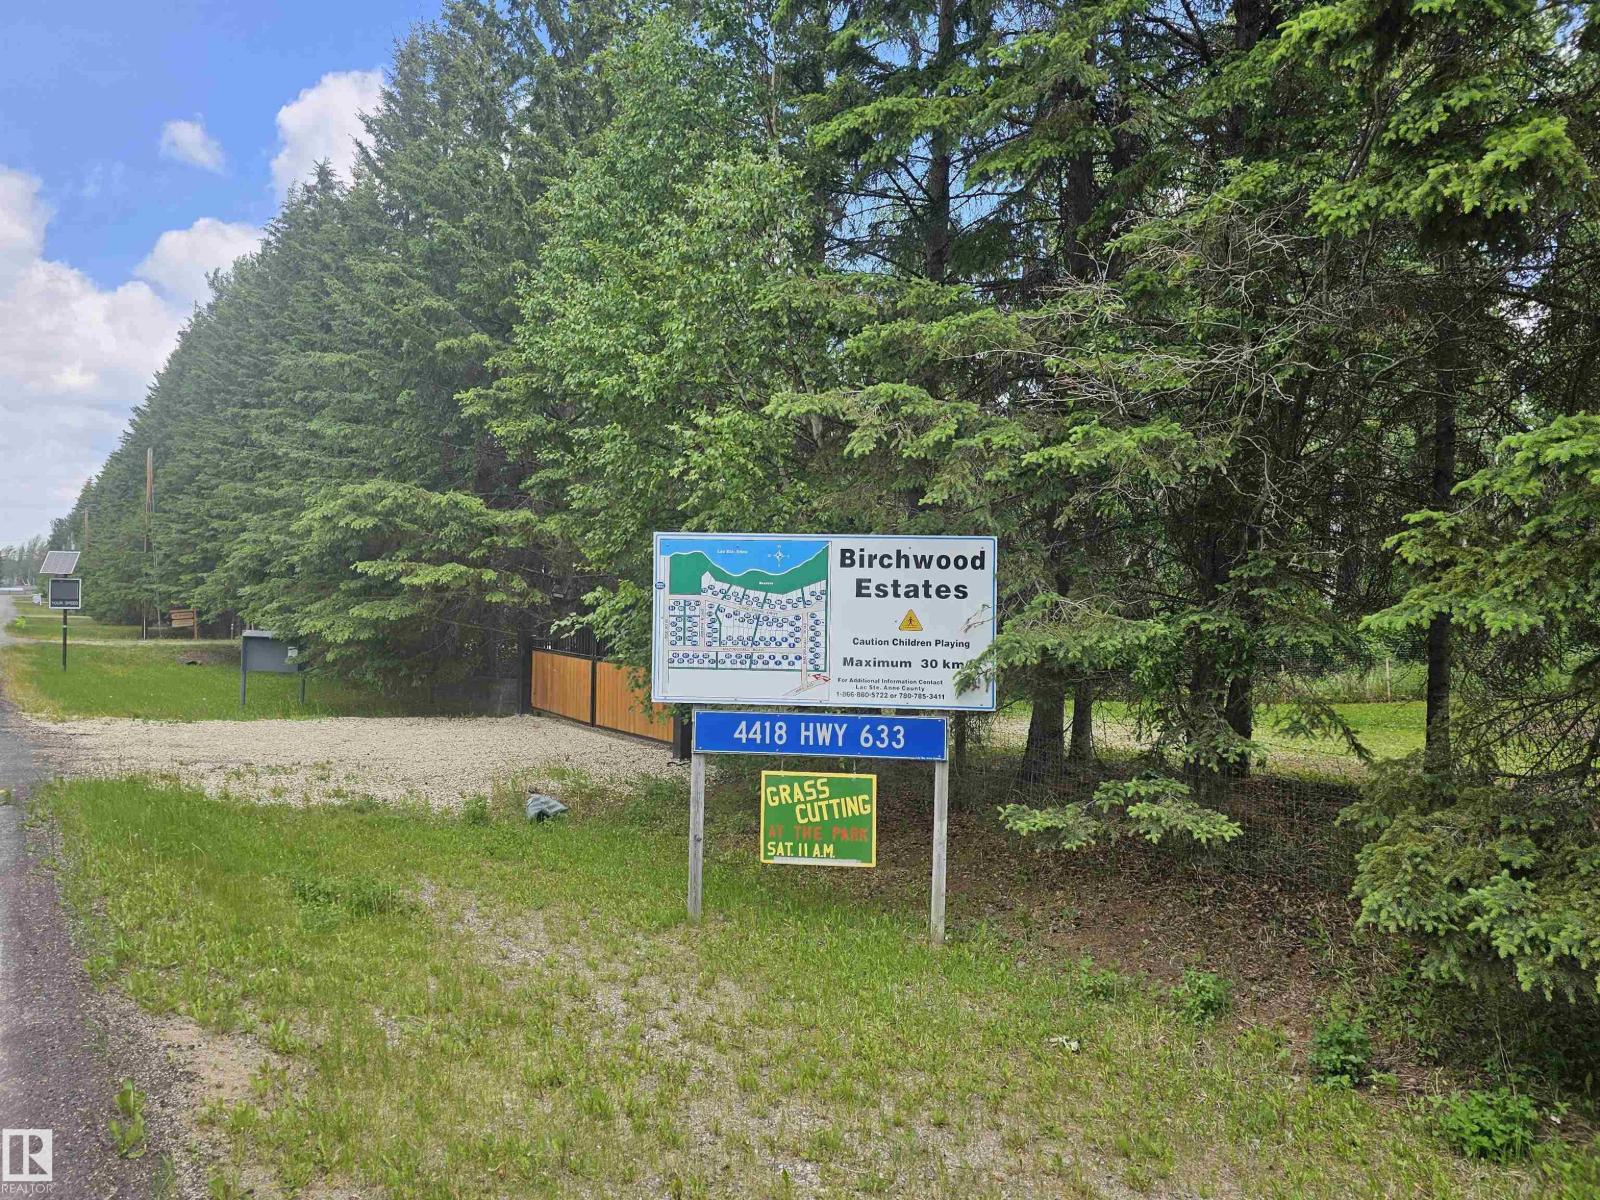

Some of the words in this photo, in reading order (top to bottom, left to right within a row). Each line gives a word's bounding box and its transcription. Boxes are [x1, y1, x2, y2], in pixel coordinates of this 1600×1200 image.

[839, 548, 986, 571] Birchwood
[855, 578, 969, 600] Estates
[852, 637, 889, 646] Caution
[892, 638, 932, 648] Children
[935, 639, 970, 649] Playing
[842, 657, 912, 669] Maximum
[921, 659, 938, 669] 30
[898, 692, 945, 700] 780-785-3411
[733, 720, 787, 745] 4418
[800, 722, 848, 747] HWY
[859, 724, 905, 749] 633
[766, 778, 830, 807] GRASS
[795, 794, 871, 824] CUTTING
[768, 825, 784, 840] AT
[794, 825, 822, 841] THE
[832, 826, 868, 842] PARK
[767, 841, 794, 857] SAT.
[798, 842, 808, 857] 11
